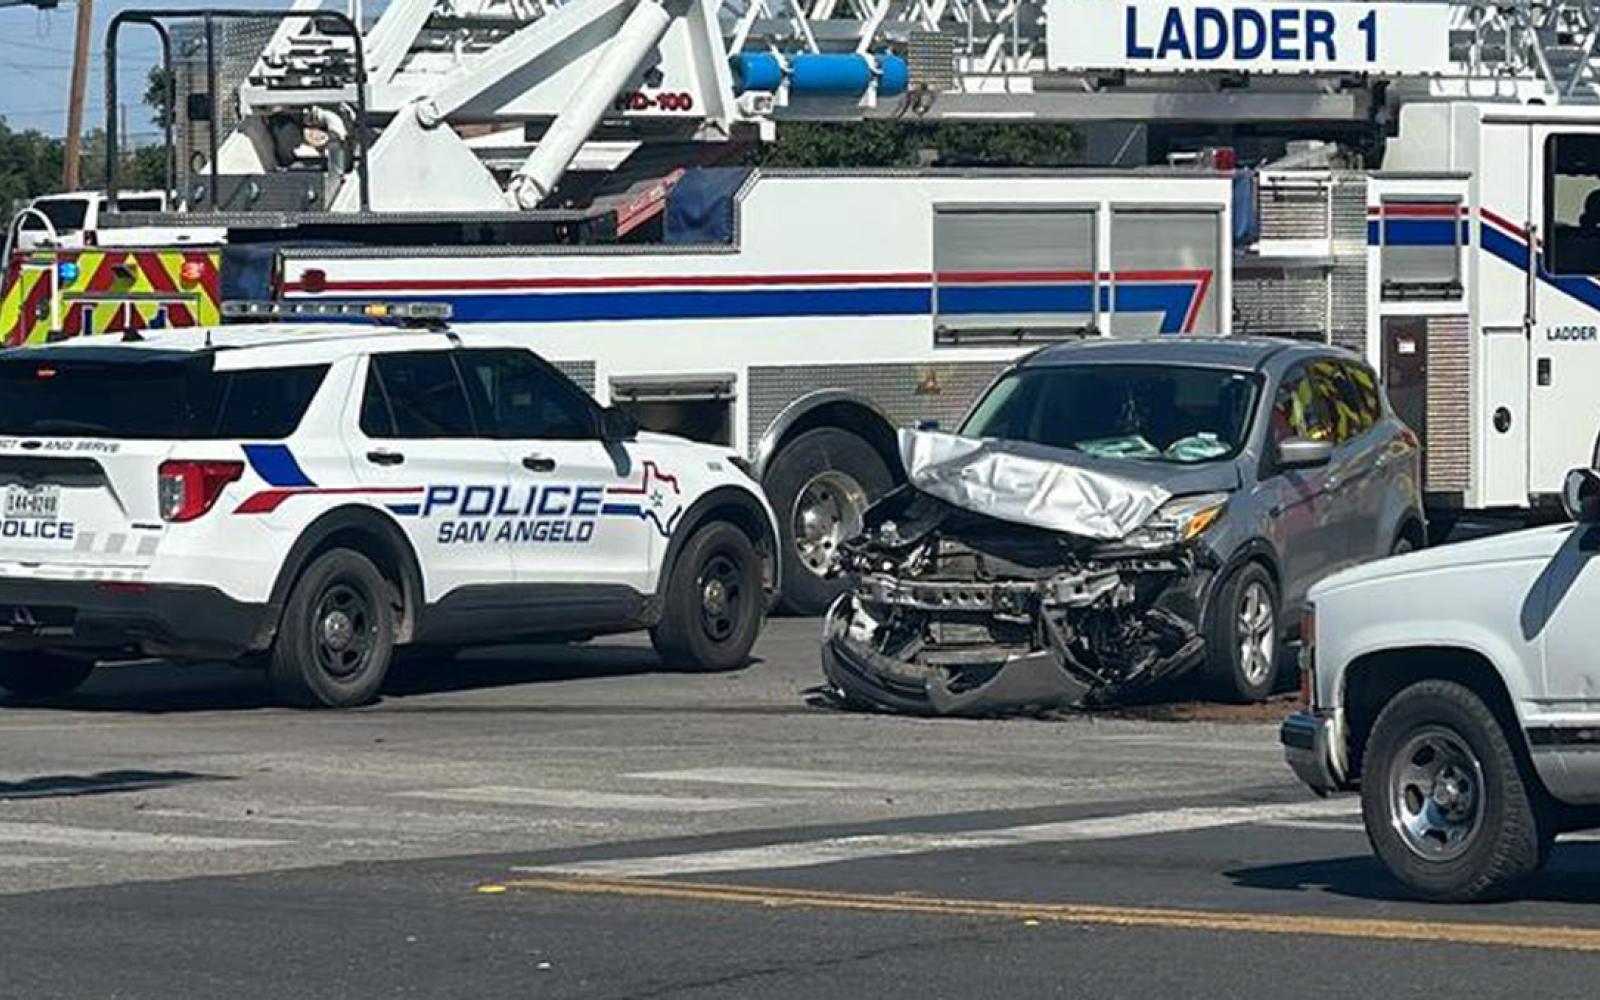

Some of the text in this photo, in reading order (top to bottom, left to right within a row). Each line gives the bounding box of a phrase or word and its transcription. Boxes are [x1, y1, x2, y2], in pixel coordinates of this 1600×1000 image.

[1126, 5, 1376, 62] LADDER 1
[1546, 325, 1597, 341] LADDER
[423, 485, 603, 518] POLICE
[0, 520, 74, 540] OLICE
[437, 521, 593, 543] SAN ANGELO
